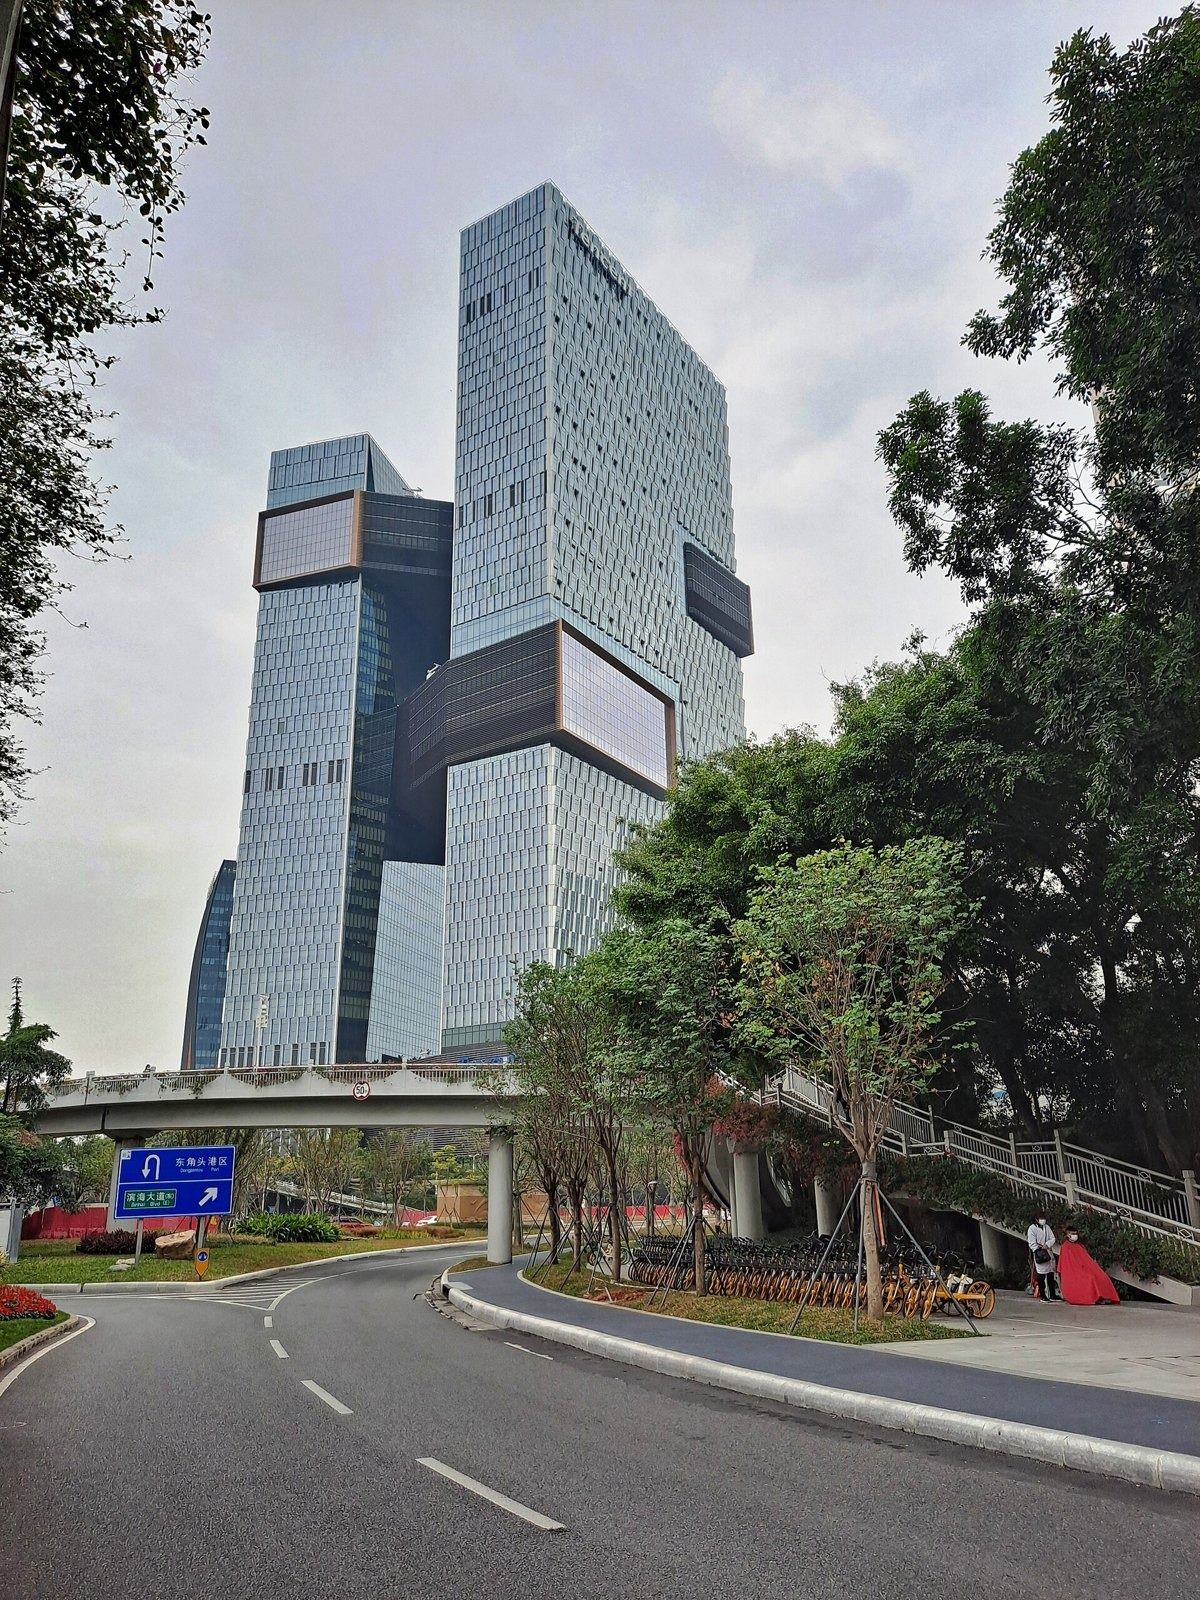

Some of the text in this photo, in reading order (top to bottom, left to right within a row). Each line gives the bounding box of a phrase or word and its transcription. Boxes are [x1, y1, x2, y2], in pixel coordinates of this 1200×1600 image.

[175, 1156, 228, 1167] 东角头港区
